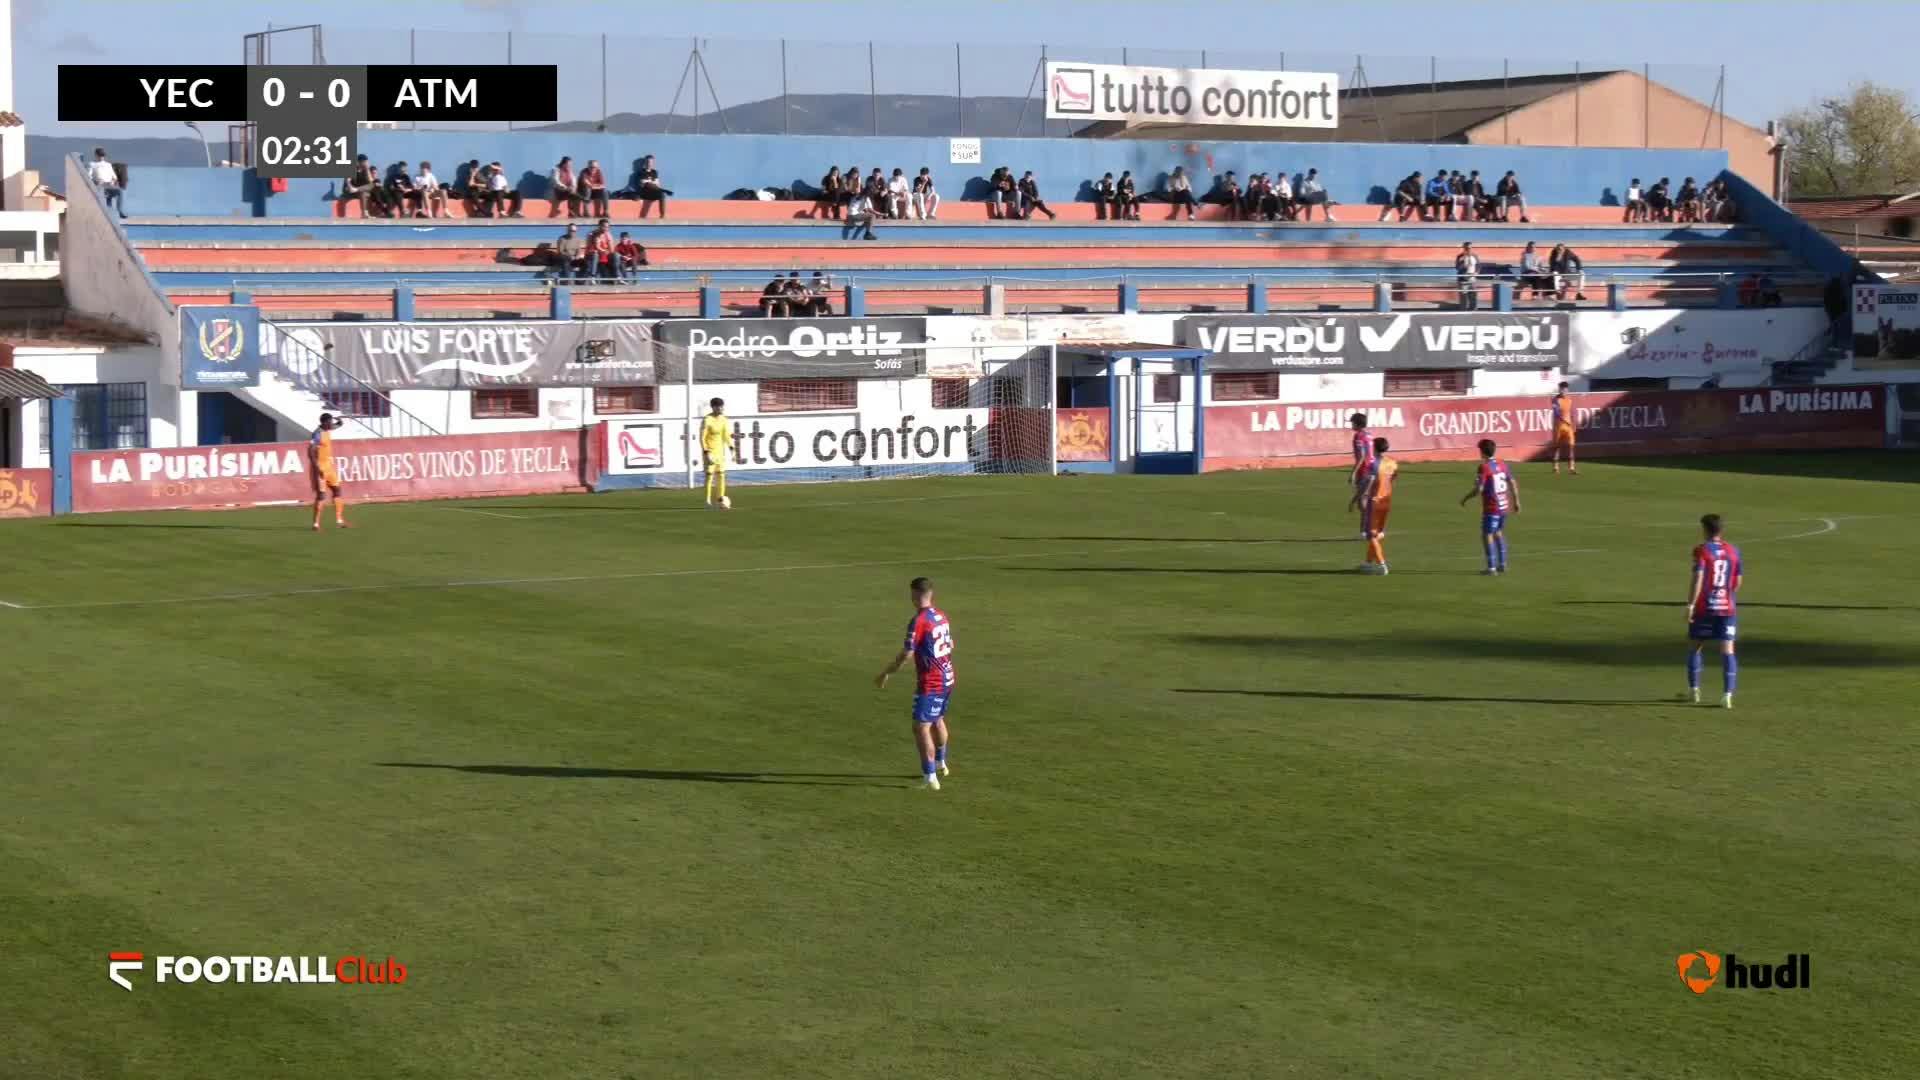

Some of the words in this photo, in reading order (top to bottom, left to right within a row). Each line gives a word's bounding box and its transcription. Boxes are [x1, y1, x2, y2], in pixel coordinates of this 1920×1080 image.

[1101, 73, 1192, 116] tutto
[1201, 79, 1334, 121] confort
[365, 329, 431, 354] LUIS
[439, 327, 533, 354] FORTE
[689, 327, 778, 358] Pedro
[788, 324, 903, 357] Ortiz
[1198, 317, 1345, 352] VERDÚ
[1421, 316, 1560, 351] VERDÚ
[874, 358, 903, 370] Sofás
[1738, 393, 1765, 414] LA
[1769, 387, 1874, 413] PURÍSIMA
[1251, 410, 1281, 432] LA
[1419, 410, 1512, 437] GRANDES
[1575, 407, 1601, 430] DE
[1607, 405, 1667, 429] YECLA
[680, 421, 796, 467] ttto
[812, 413, 978, 463] confort
[91, 458, 132, 484] LA
[139, 448, 304, 481] PURÍSIMA
[418, 449, 476, 481] VINOS
[480, 449, 509, 476] DE
[509, 445, 571, 473] YECLA
[1713, 559, 1728, 587] 8
